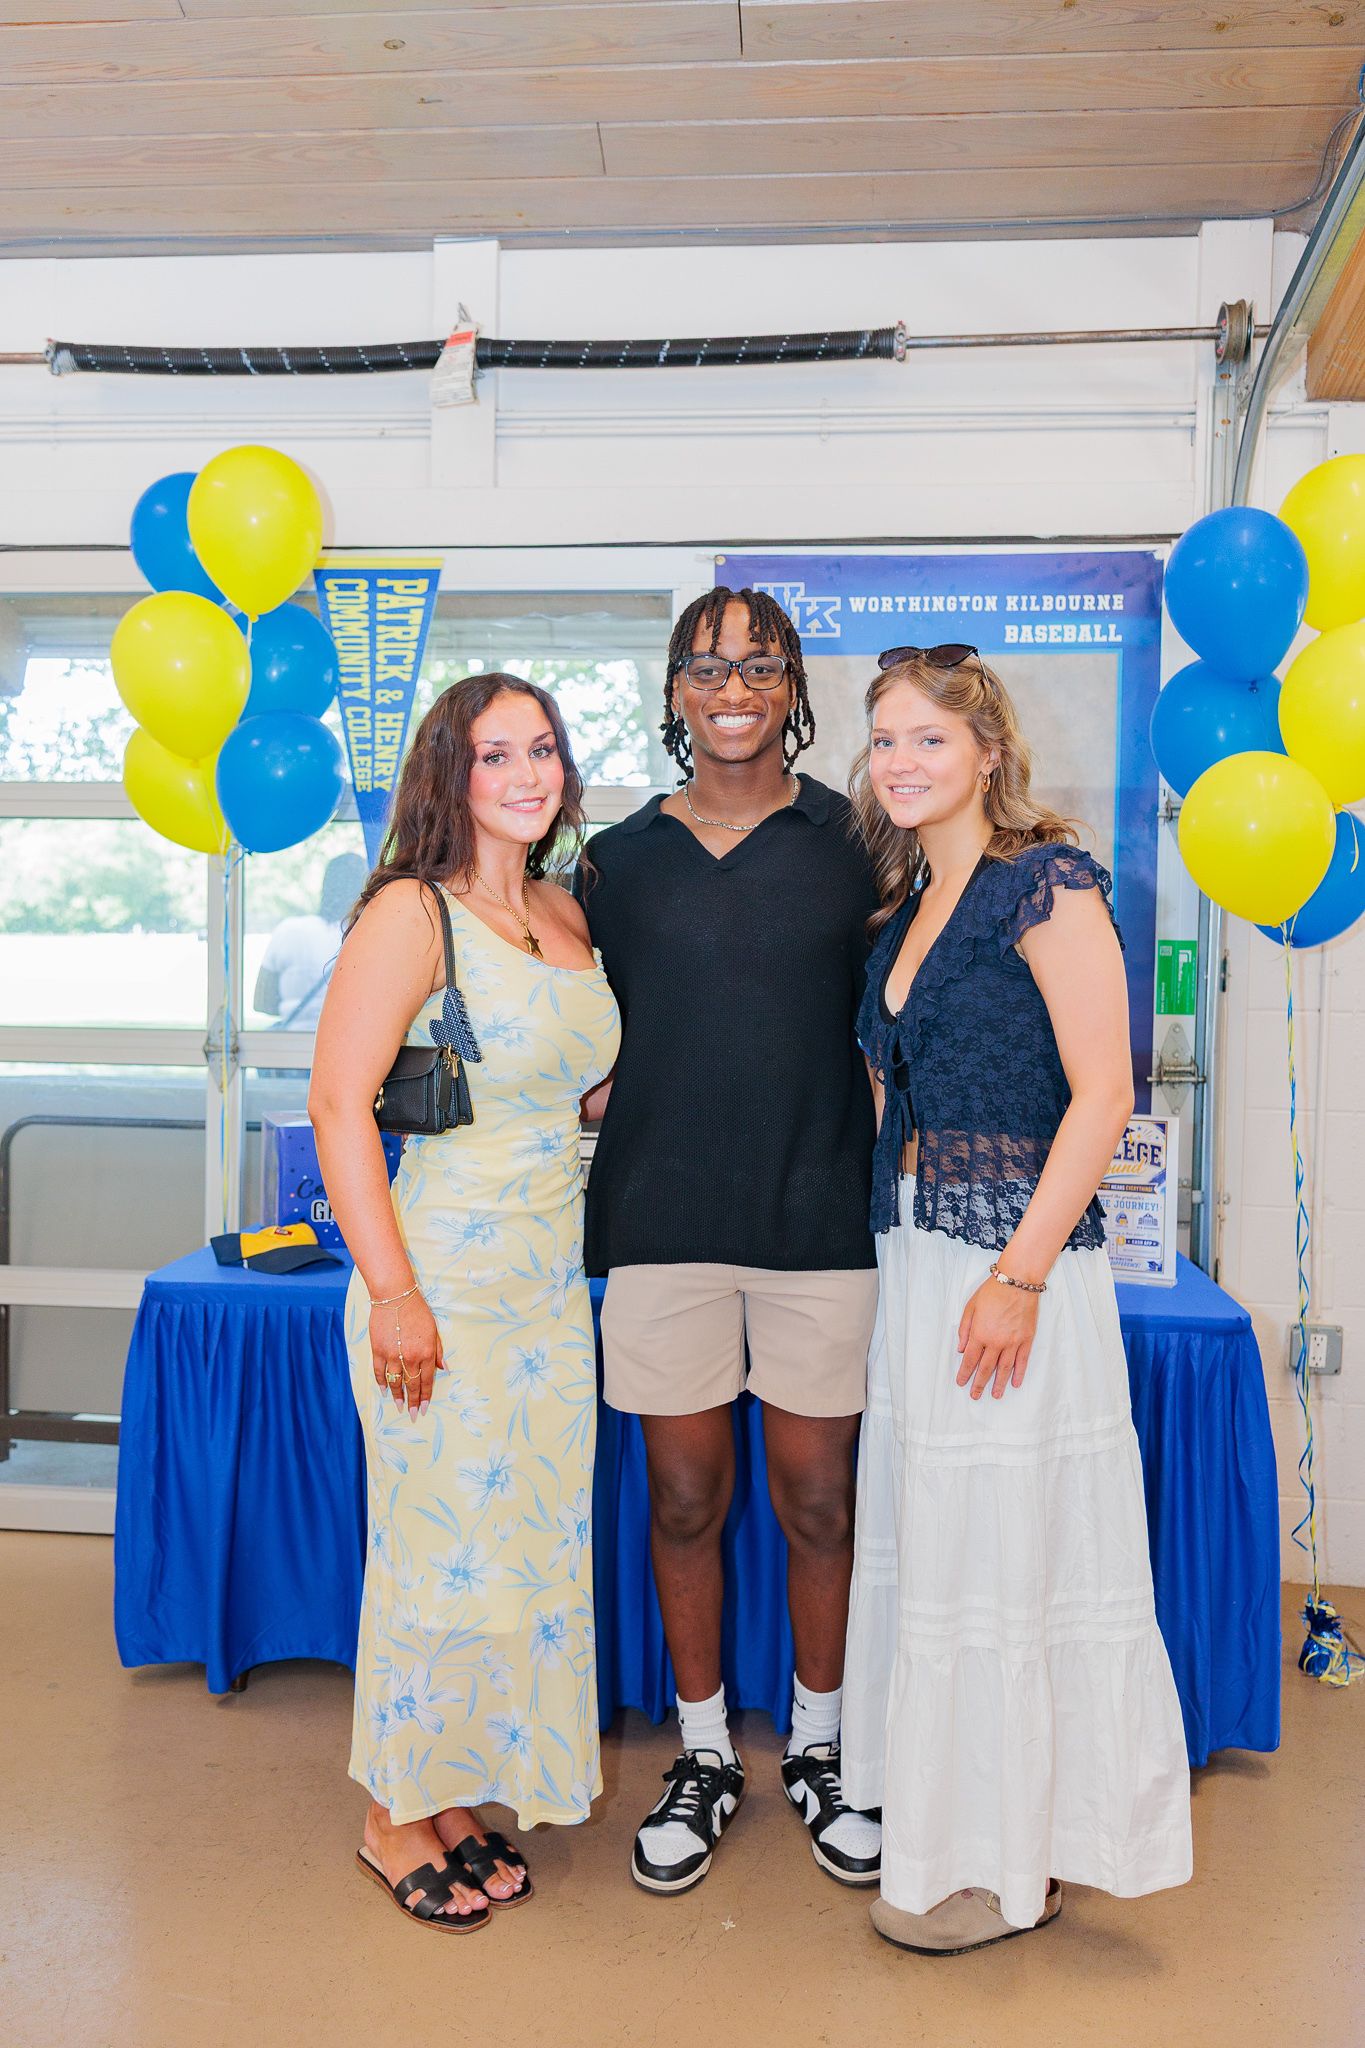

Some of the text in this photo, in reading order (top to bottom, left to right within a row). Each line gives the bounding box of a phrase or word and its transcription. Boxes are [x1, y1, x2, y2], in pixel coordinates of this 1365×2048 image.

[849, 595, 998, 613] WORTHINGTON
[1006, 594, 1124, 612] KILBOURNE
[1004, 623, 1123, 644] BASEBALL
[324, 578, 373, 793] COMMUNITY COLLEGE
[373, 578, 430, 793] PATRICK & HENRY
[1114, 1200, 1159, 1212] JOURNEY!
